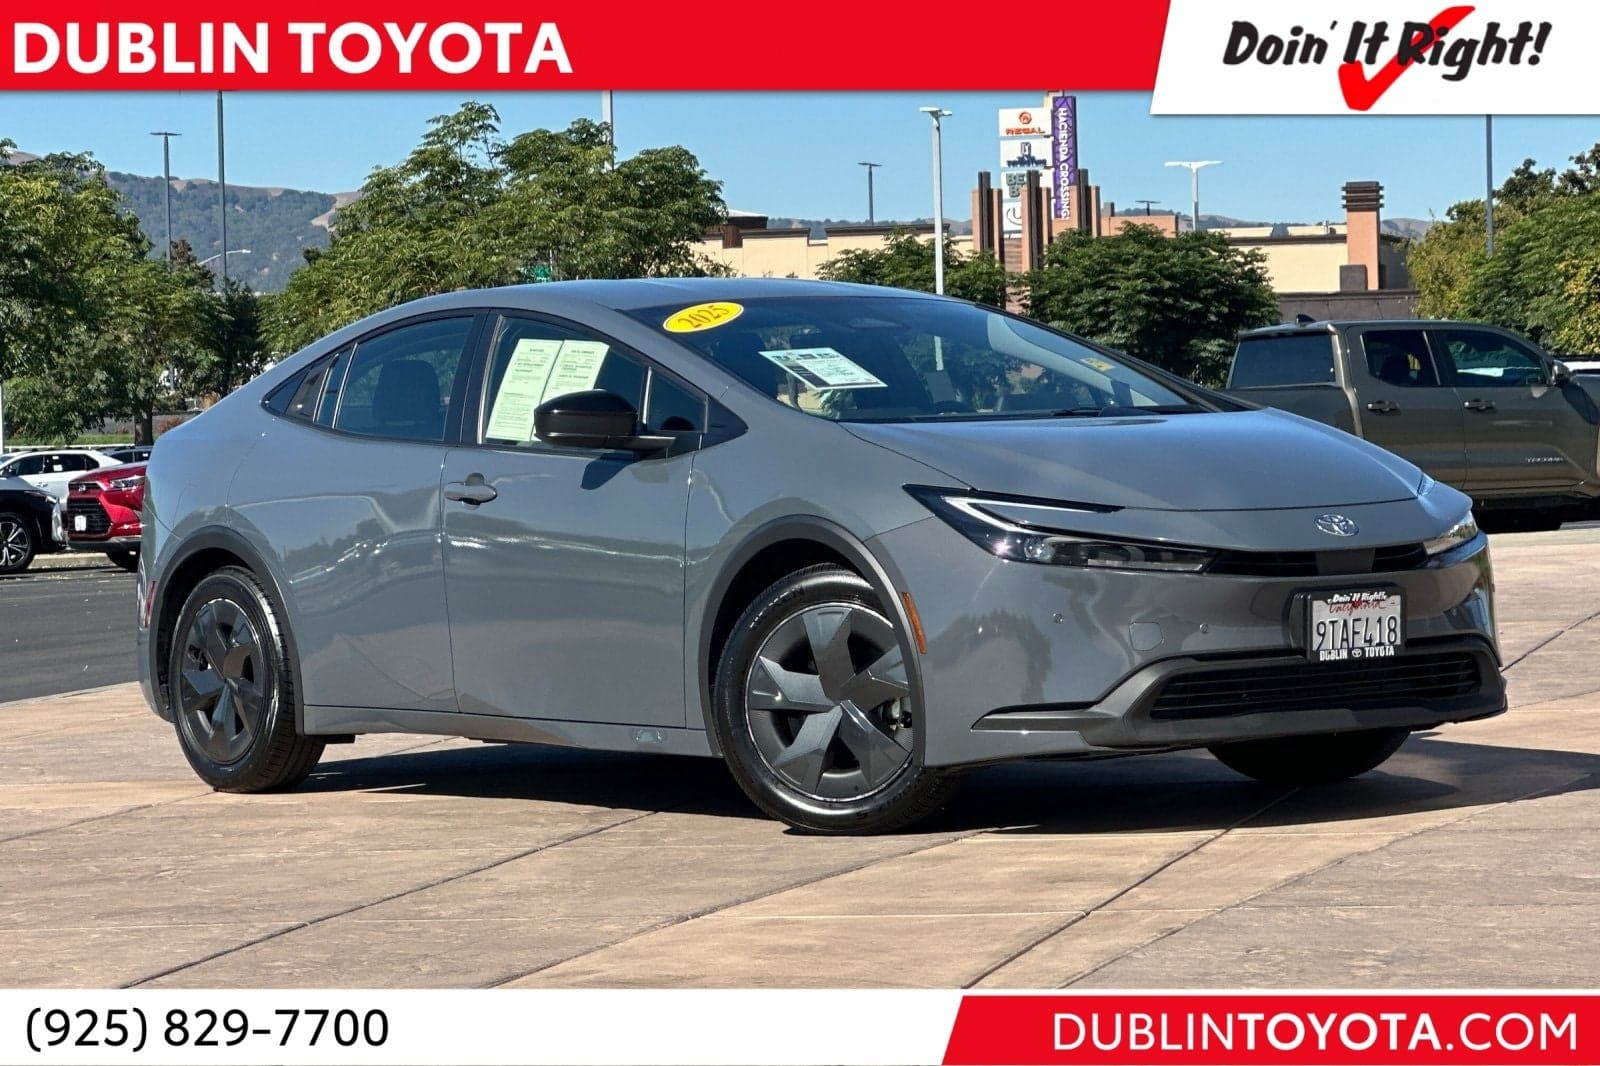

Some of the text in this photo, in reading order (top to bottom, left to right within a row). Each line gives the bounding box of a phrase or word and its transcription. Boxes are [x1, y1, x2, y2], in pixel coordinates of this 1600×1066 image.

[1005, 126, 1046, 136] REGAL
[1058, 107, 1070, 220] HACIENDA CROSSING
[677, 305, 731, 329] 2025
[1316, 615, 1398, 652] 9TAF418
[1320, 646, 1395, 661] DUBLIN TOYOTA
